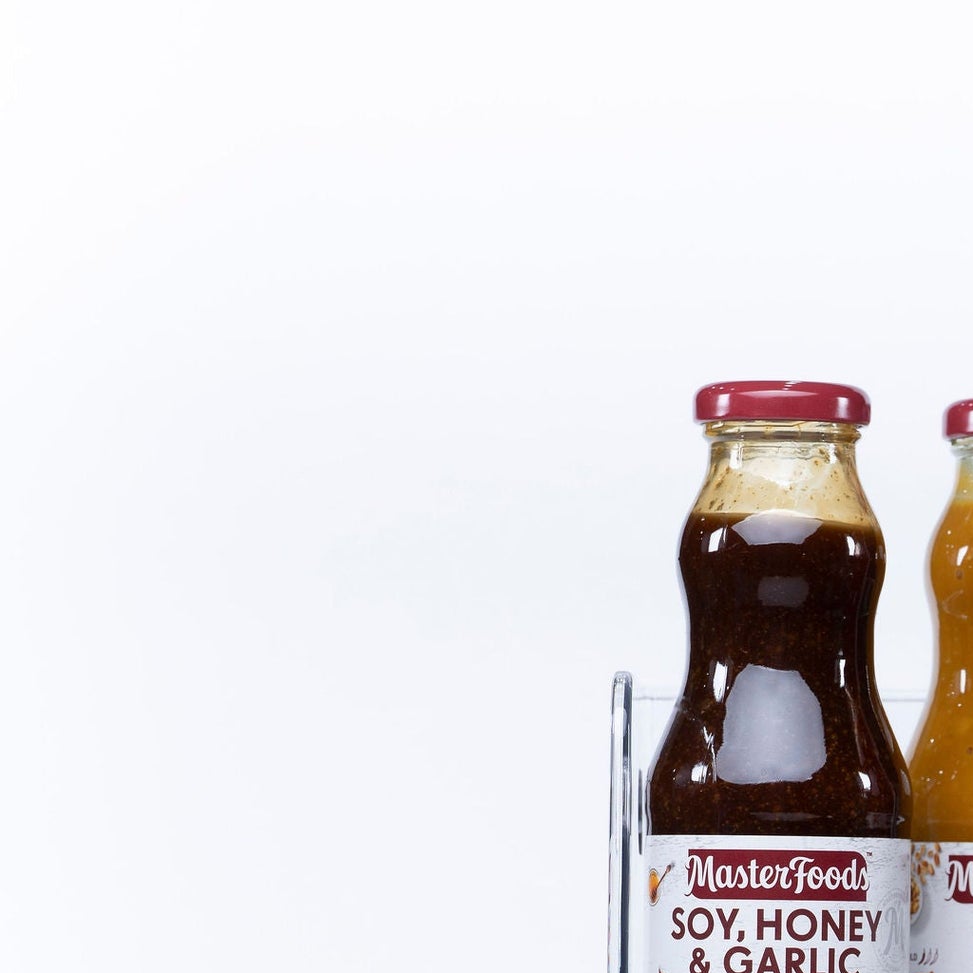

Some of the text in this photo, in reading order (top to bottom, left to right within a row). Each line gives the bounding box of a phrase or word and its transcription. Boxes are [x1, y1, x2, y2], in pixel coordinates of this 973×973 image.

[685, 855, 870, 896] MasterFoods
[671, 907, 882, 942] SOY, HONEY
